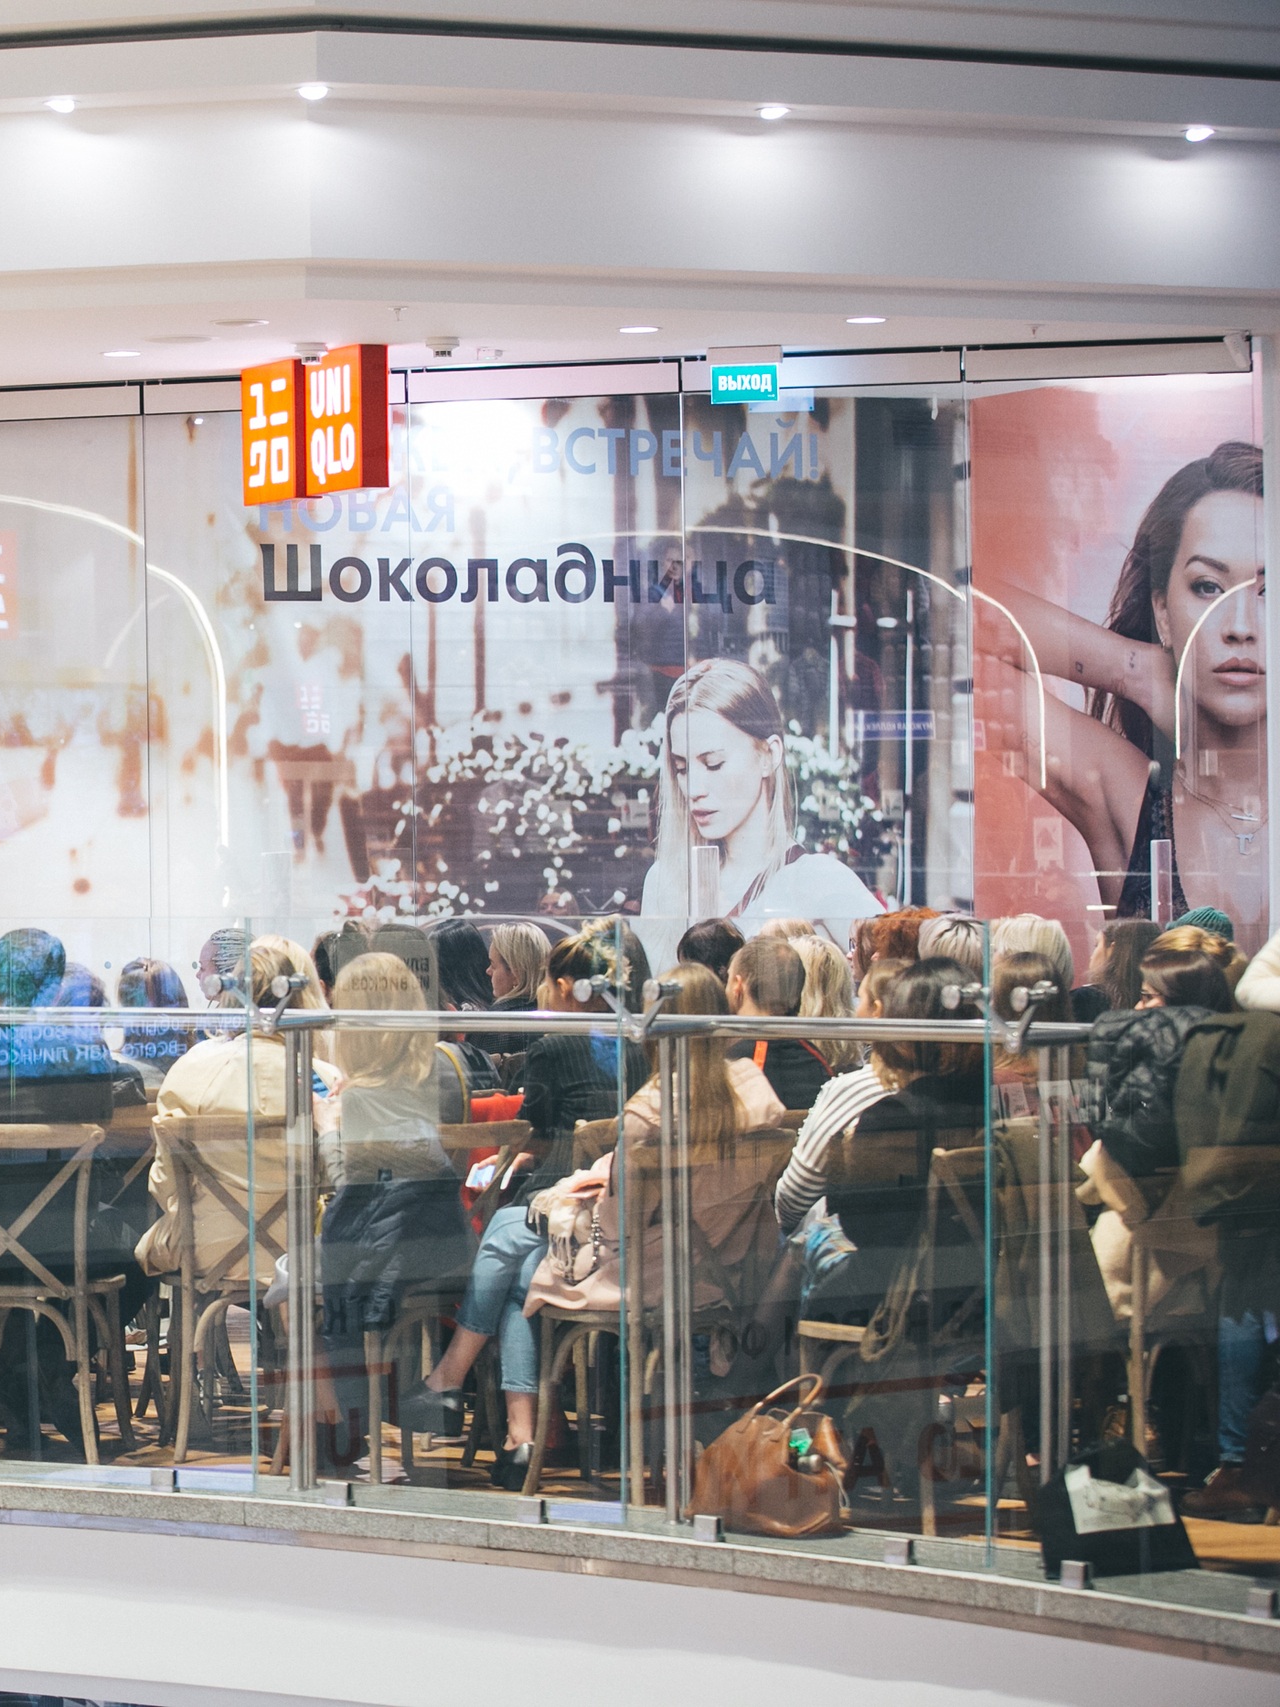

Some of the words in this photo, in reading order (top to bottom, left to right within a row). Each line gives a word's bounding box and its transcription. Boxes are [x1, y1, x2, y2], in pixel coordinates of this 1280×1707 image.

[310, 364, 351, 419] UNI
[718, 374, 772, 392] ВЫХОД
[310, 422, 356, 485] QLO
[532, 418, 820, 480] ВСТРЕЧАЙ!
[260, 485, 456, 533] НОВАЯ
[261, 542, 778, 614] Шоколадница
